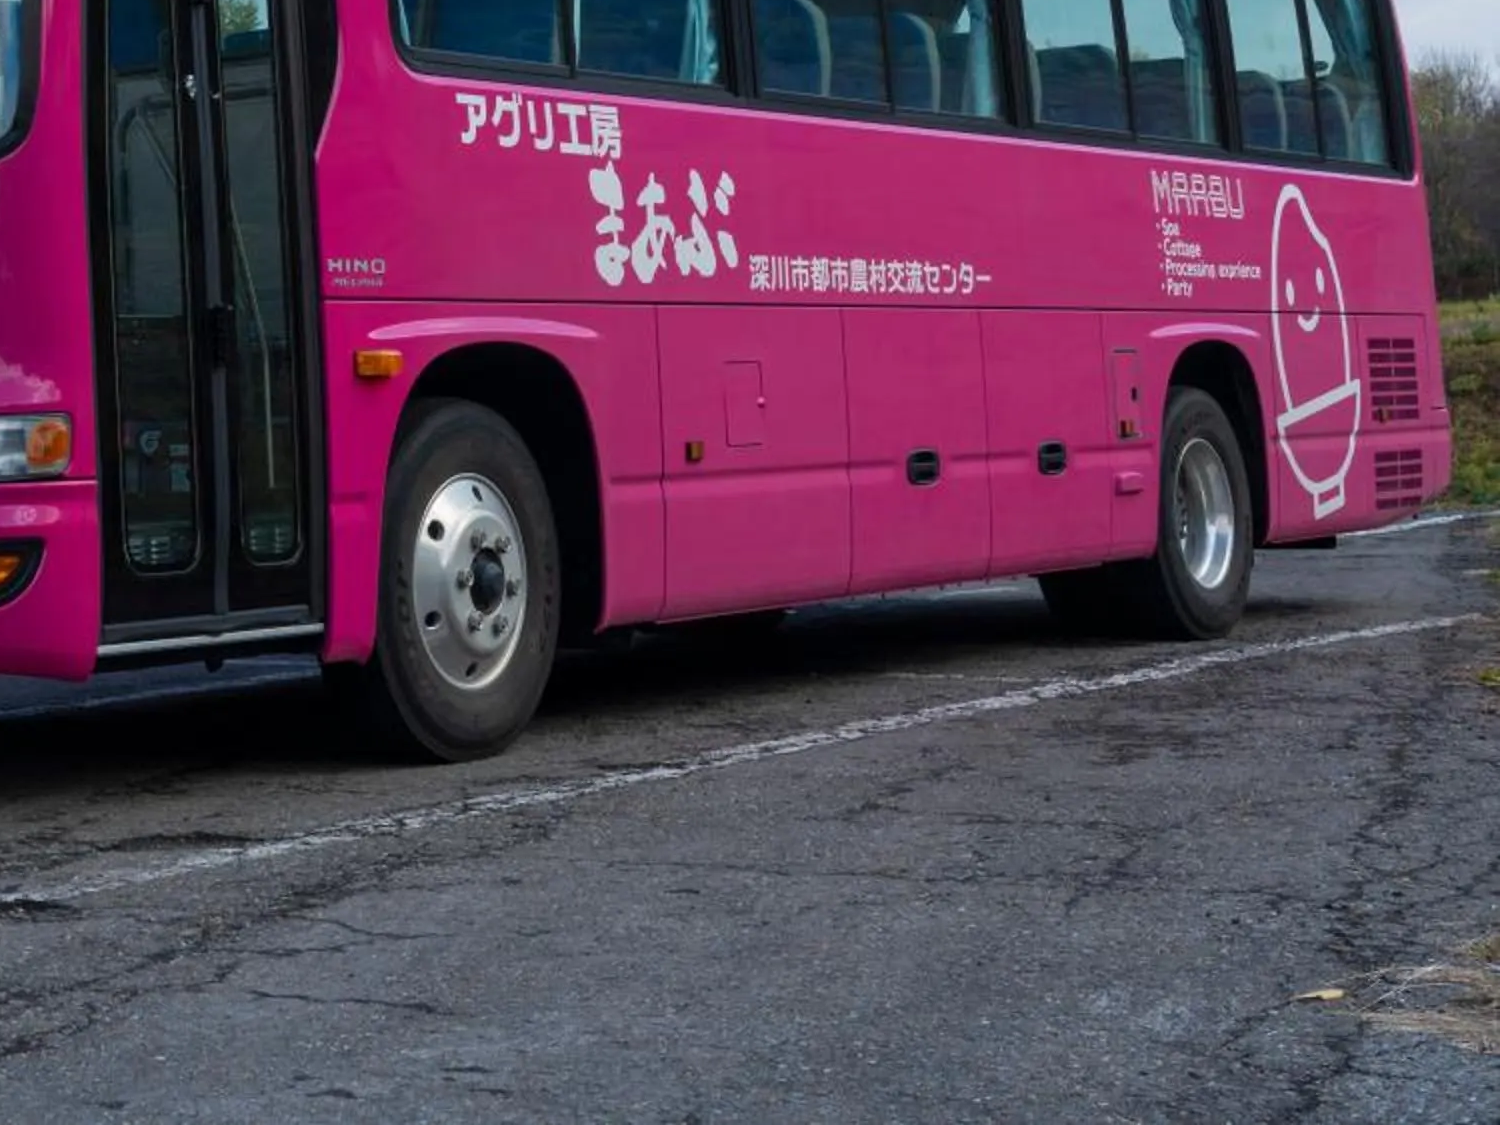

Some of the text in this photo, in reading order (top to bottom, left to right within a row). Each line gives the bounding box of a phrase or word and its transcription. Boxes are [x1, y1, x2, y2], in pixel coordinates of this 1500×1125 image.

[455, 92, 622, 160] アグリ工房
[588, 162, 738, 286] まあぶ
[327, 258, 385, 274] HINO
[749, 254, 992, 294] 深川市都市農村交流センター
